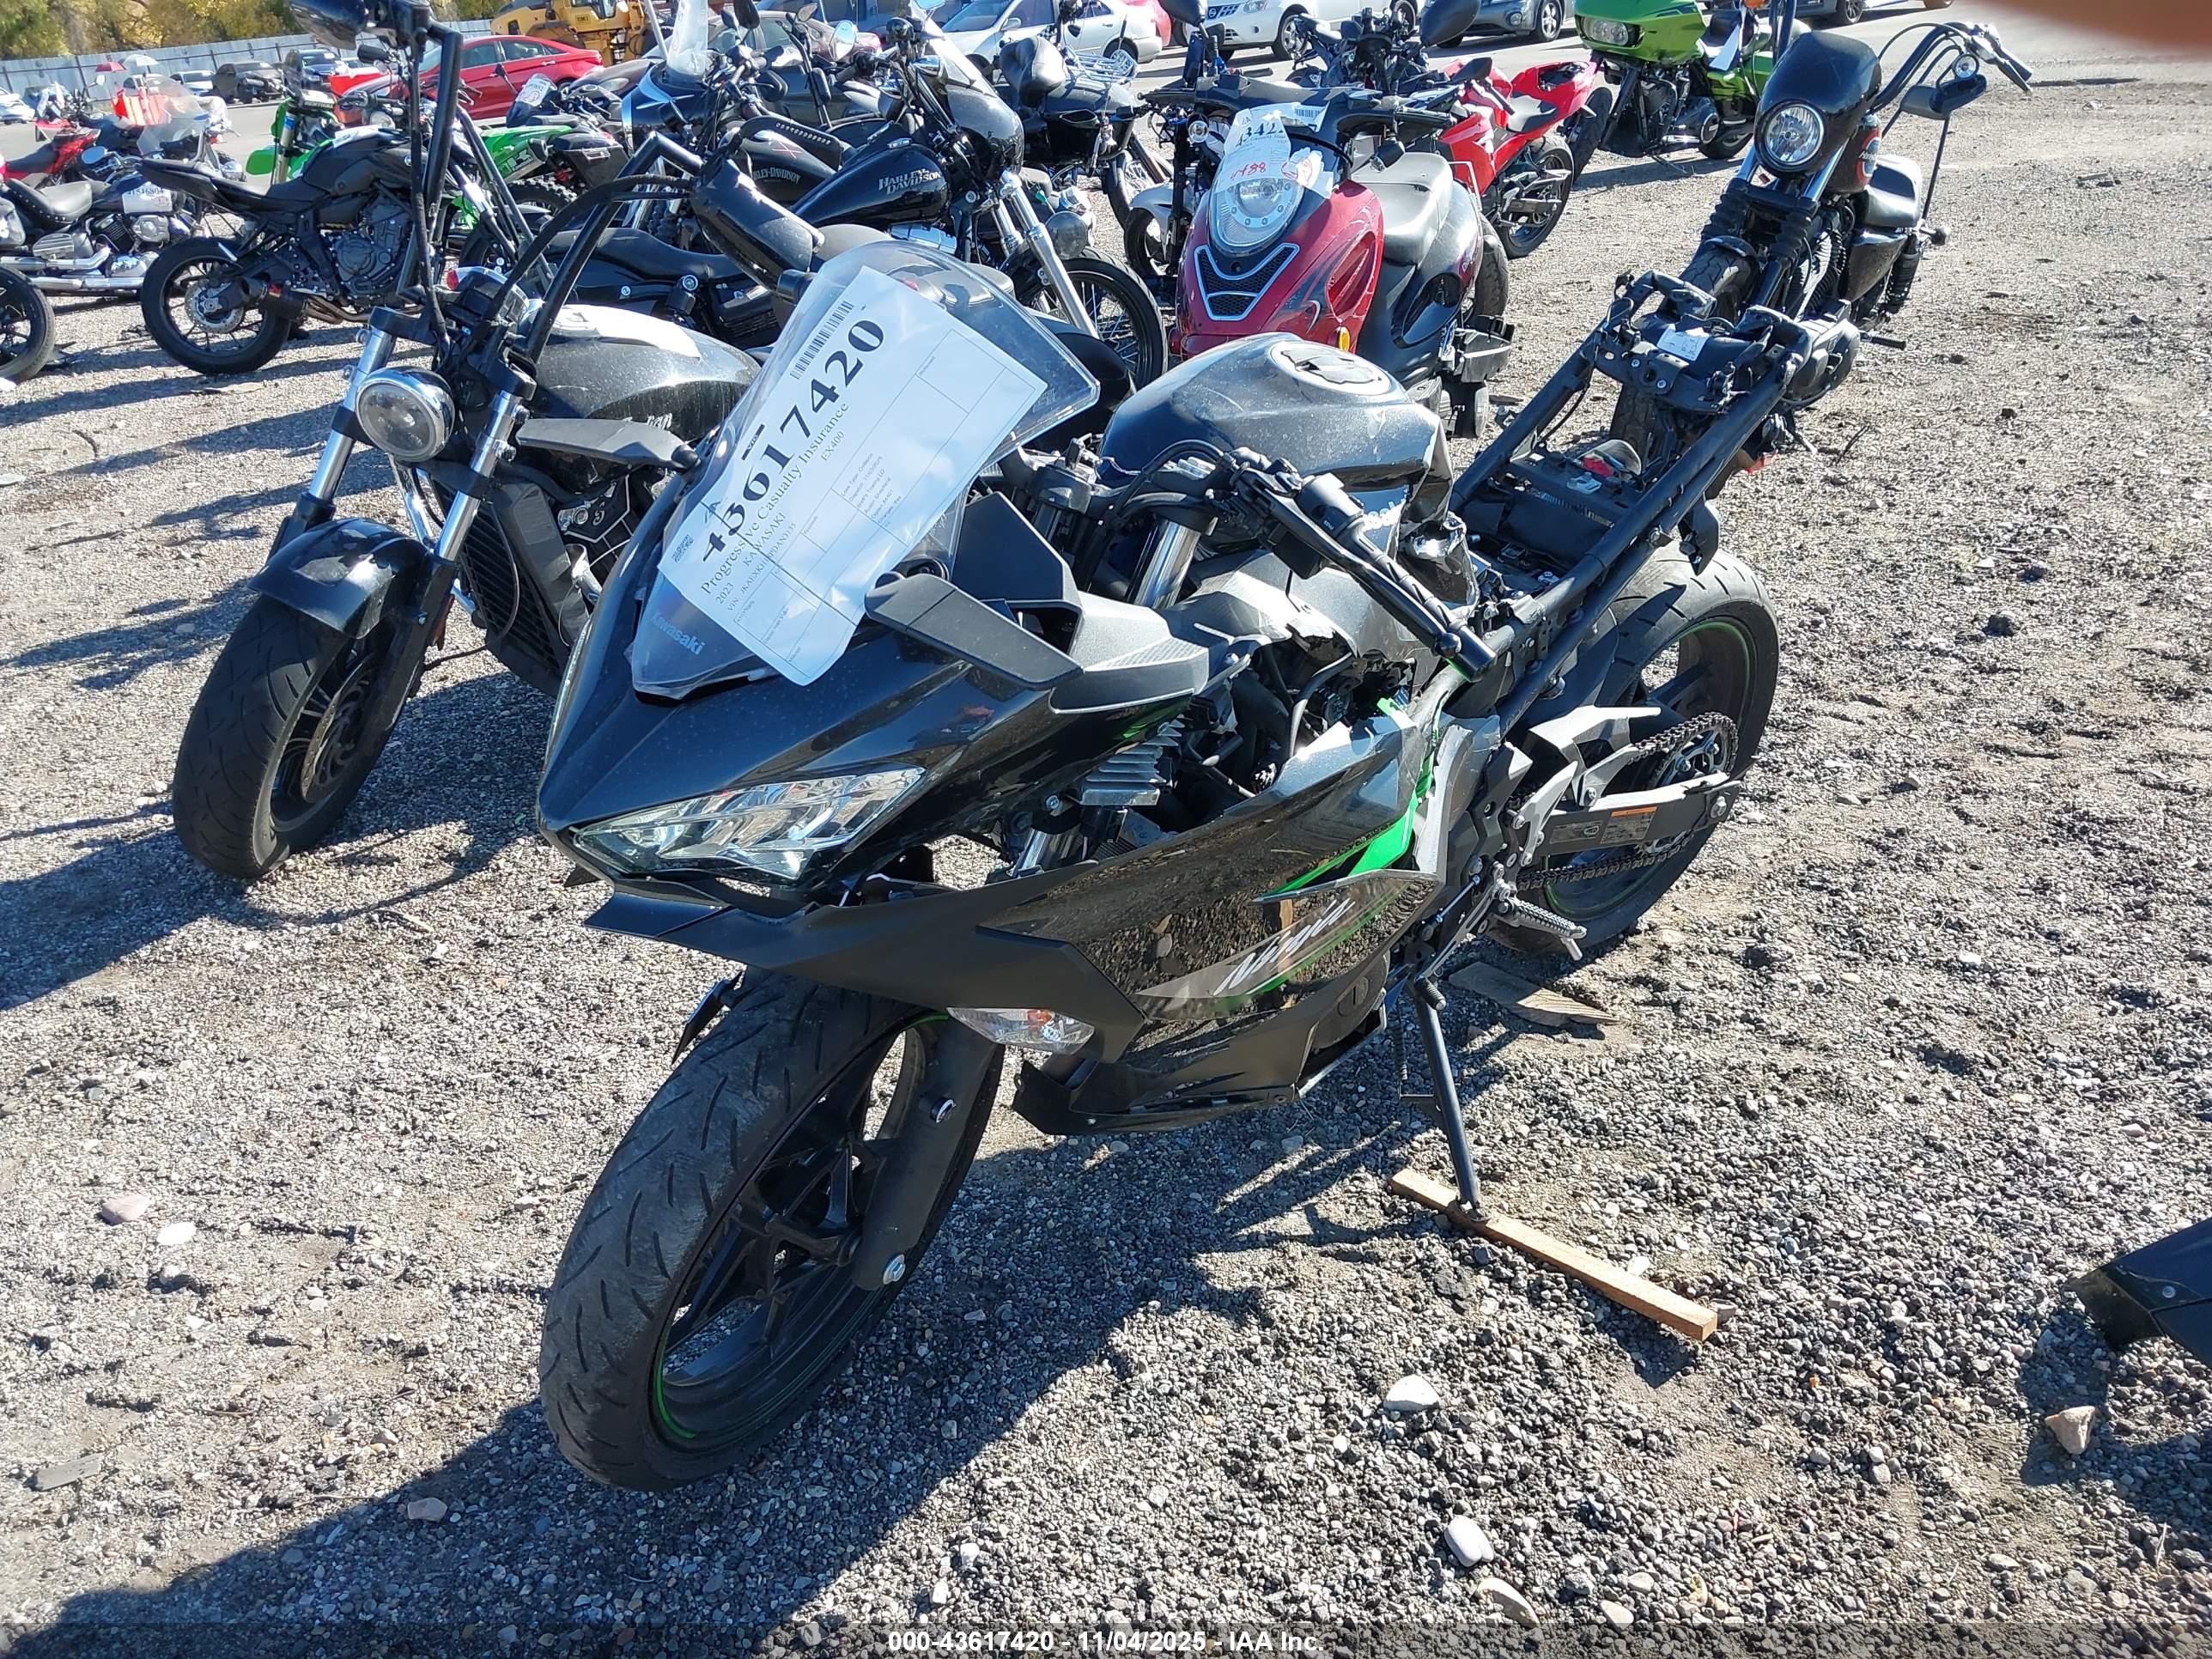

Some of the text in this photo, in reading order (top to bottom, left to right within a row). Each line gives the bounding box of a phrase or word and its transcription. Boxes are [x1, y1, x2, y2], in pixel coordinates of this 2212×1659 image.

[878, 168, 930, 191] HARLEY
[886, 170, 943, 195] DAVIDSON
[702, 320, 884, 562] 43617420
[758, 465, 801, 520] Casualty
[799, 397, 848, 463] Insurance
[716, 583, 733, 604] 2023
[743, 513, 786, 566] KAWASAKI
[821, 431, 844, 461] EX400
